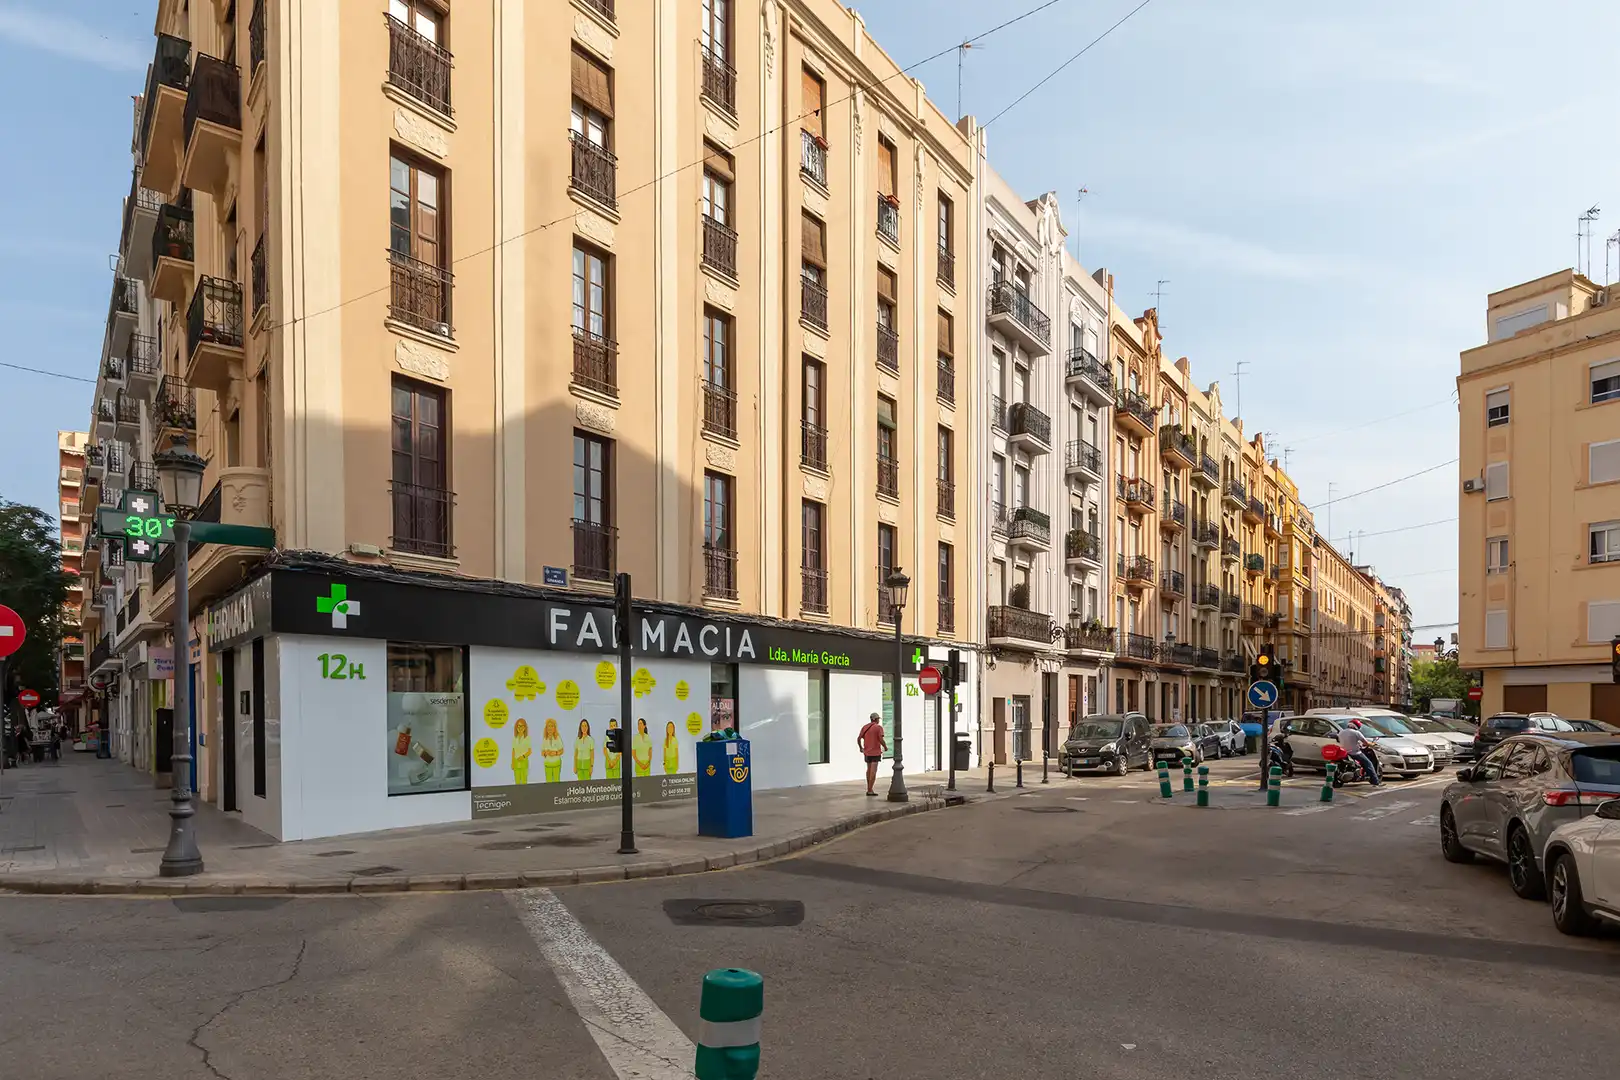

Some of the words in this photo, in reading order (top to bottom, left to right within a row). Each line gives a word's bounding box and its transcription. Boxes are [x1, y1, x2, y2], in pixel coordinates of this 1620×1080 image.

[769, 646, 790, 662] Lda.
[792, 648, 819, 664] María
[821, 651, 850, 666] García
[586, 784, 622, 794] Monteolive
[554, 796, 582, 805] Estamos
[597, 793, 609, 802] para
